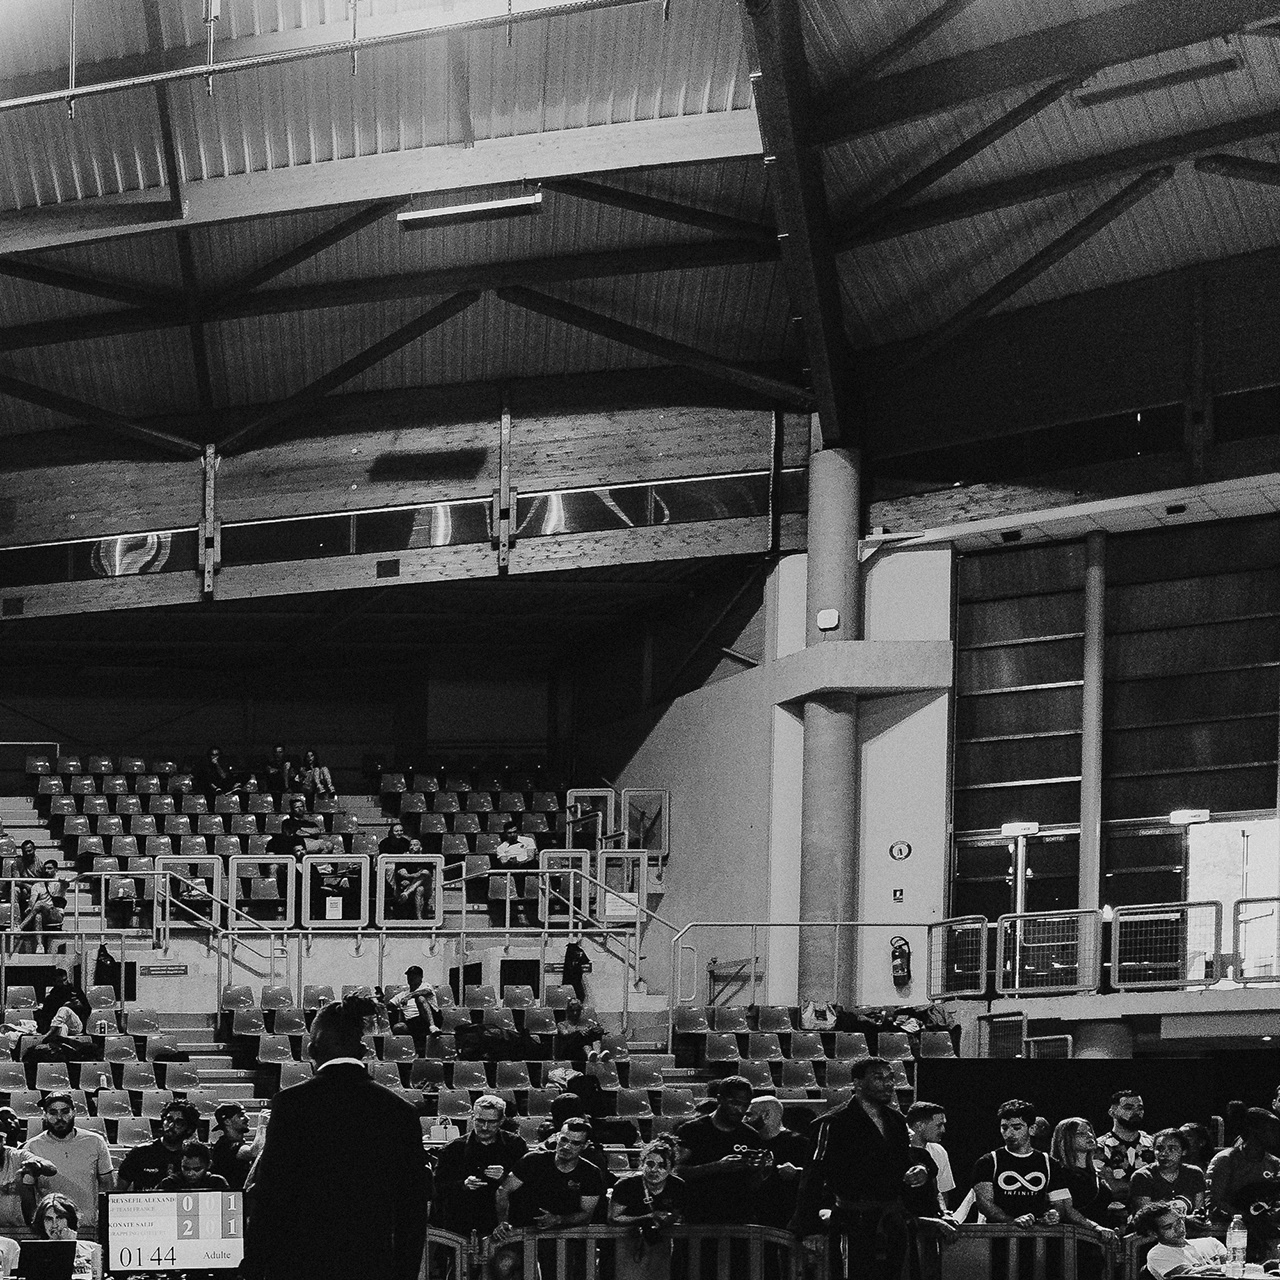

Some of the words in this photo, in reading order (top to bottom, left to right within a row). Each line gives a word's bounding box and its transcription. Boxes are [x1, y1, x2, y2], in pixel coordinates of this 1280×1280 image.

[182, 1195, 193, 1212] 0
[228, 1194, 237, 1211] 1
[183, 1220, 193, 1236] 2
[228, 1219, 237, 1235] 1
[203, 1251, 231, 1260] Adulte
